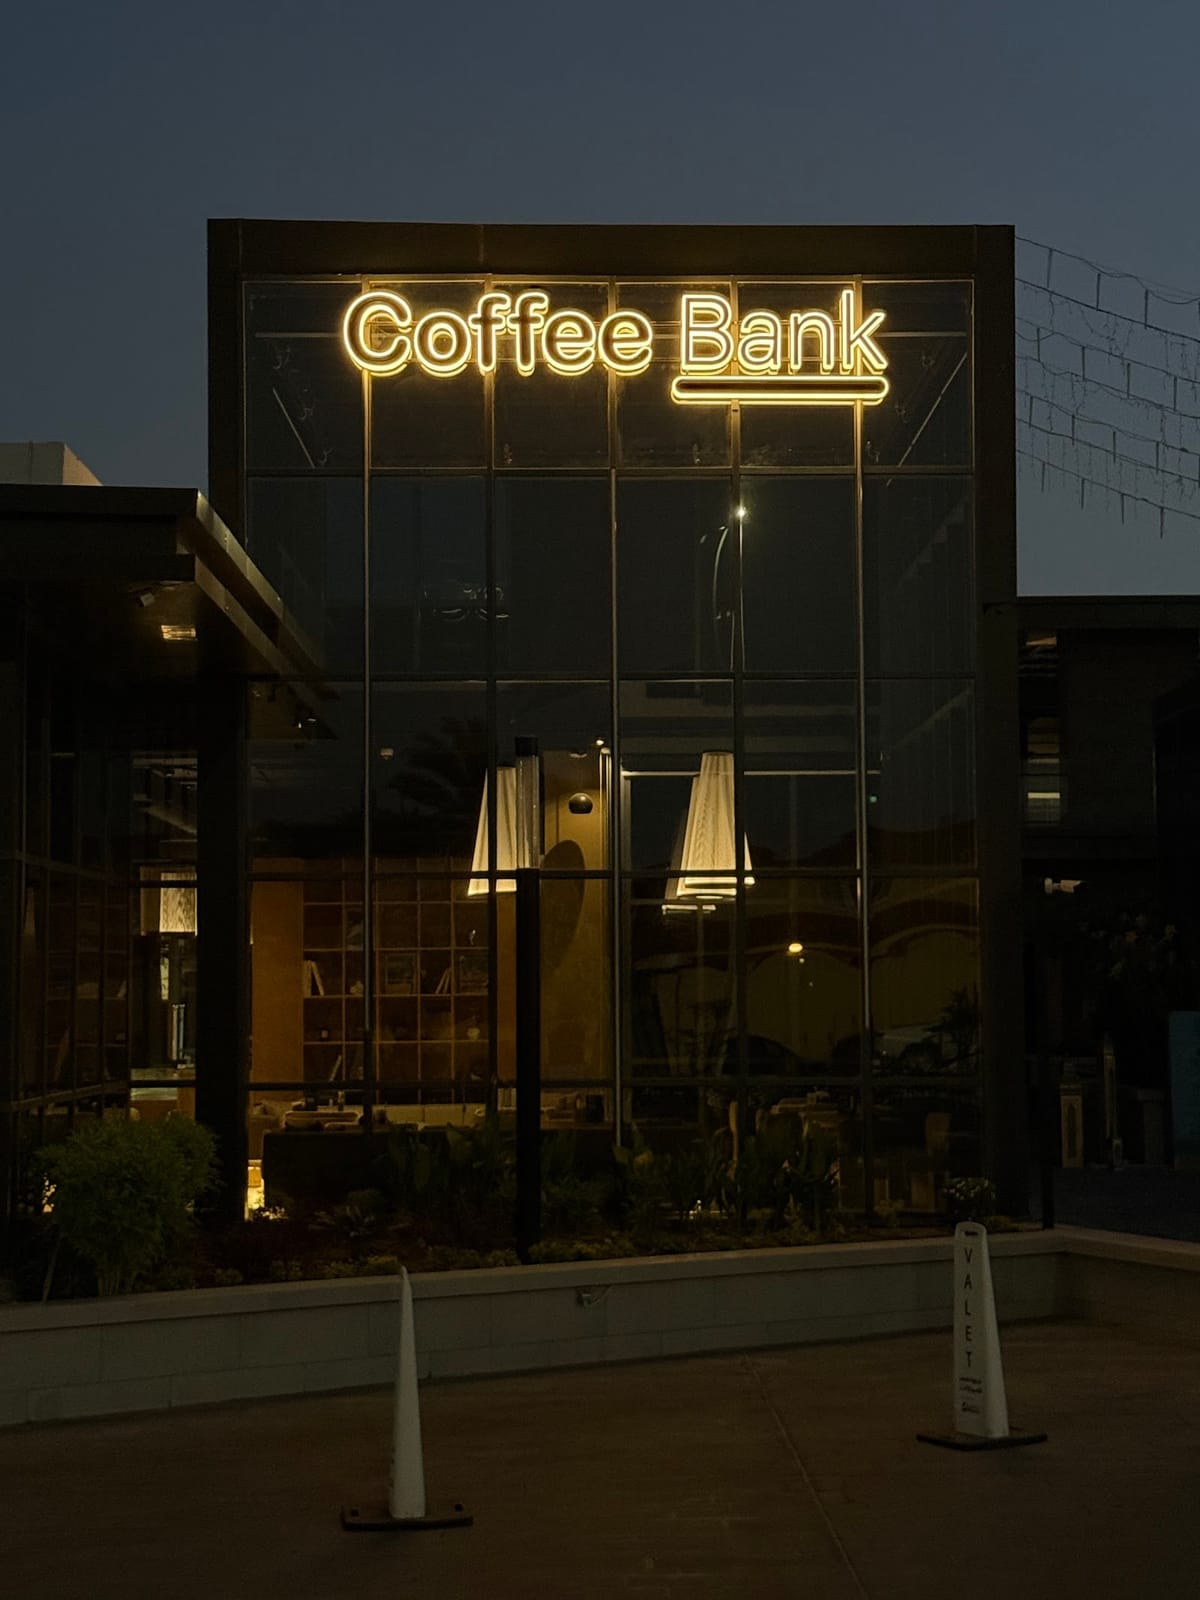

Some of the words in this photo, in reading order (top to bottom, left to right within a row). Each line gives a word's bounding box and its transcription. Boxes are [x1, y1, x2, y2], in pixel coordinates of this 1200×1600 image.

[342, 290, 655, 378] Coffee
[679, 289, 890, 375] Bank
[963, 1247, 973, 1368] VALET
